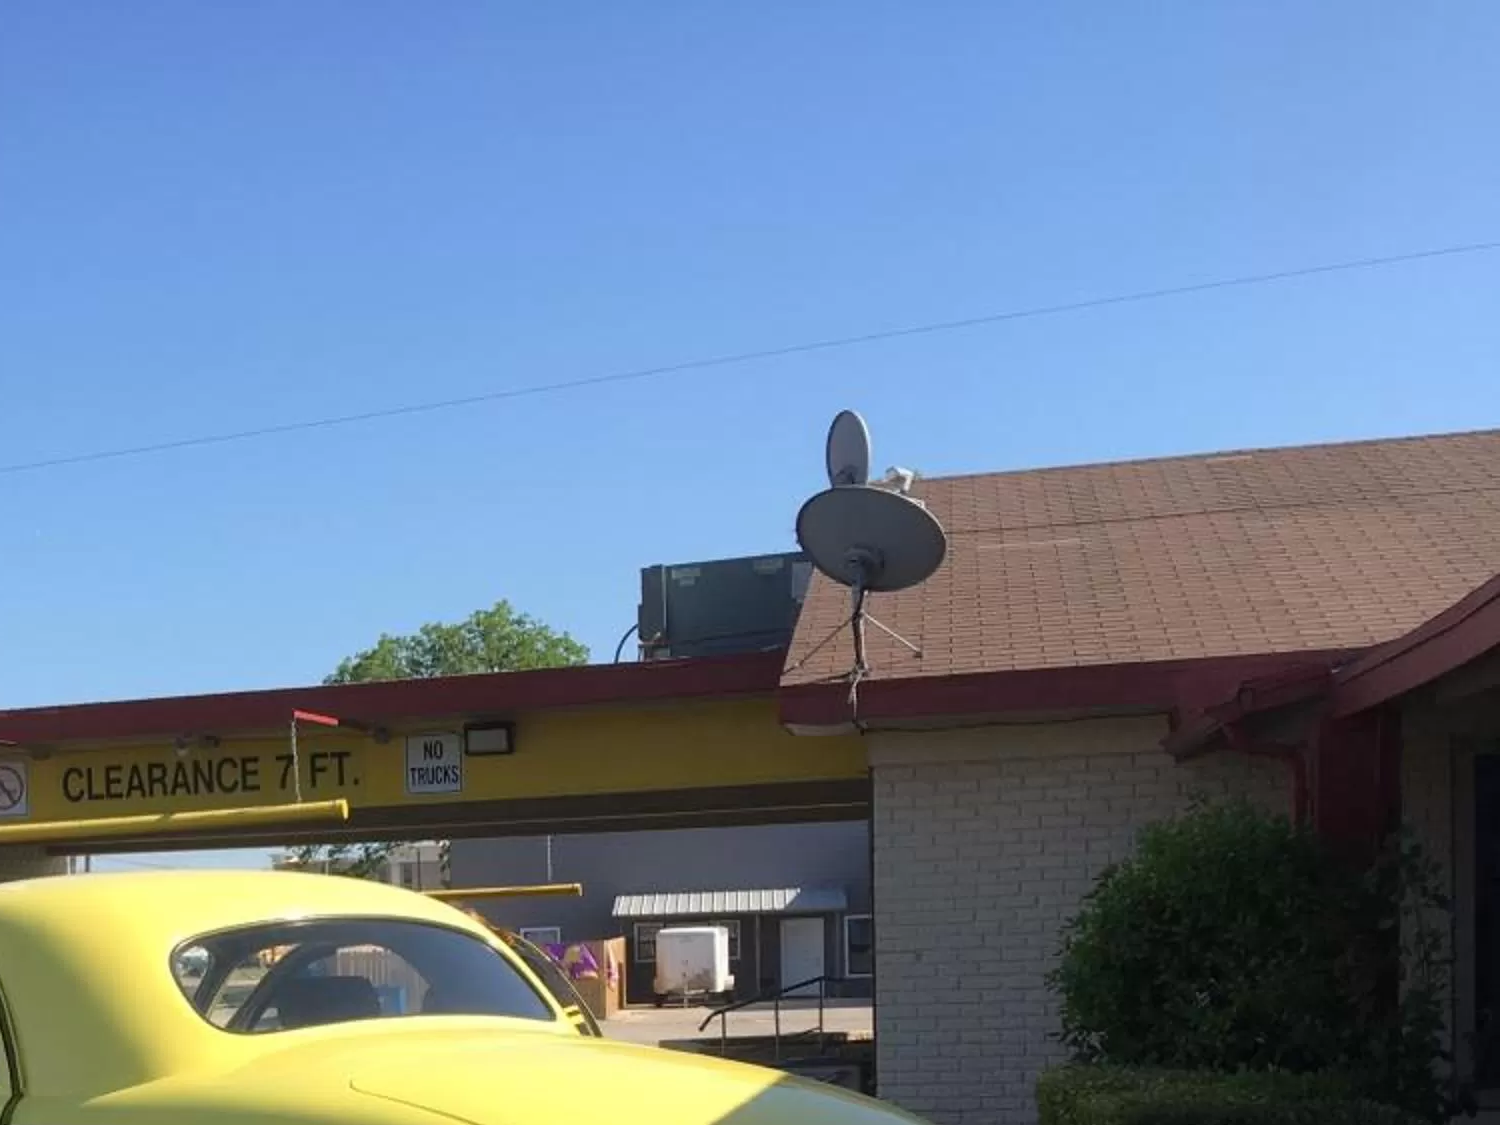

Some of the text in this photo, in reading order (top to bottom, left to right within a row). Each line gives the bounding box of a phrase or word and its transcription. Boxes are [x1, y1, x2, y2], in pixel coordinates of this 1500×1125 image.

[423, 740, 443, 761] NO
[62, 751, 360, 802] CLEARANCE 7 FT.
[410, 765, 459, 787] TRUCKS
